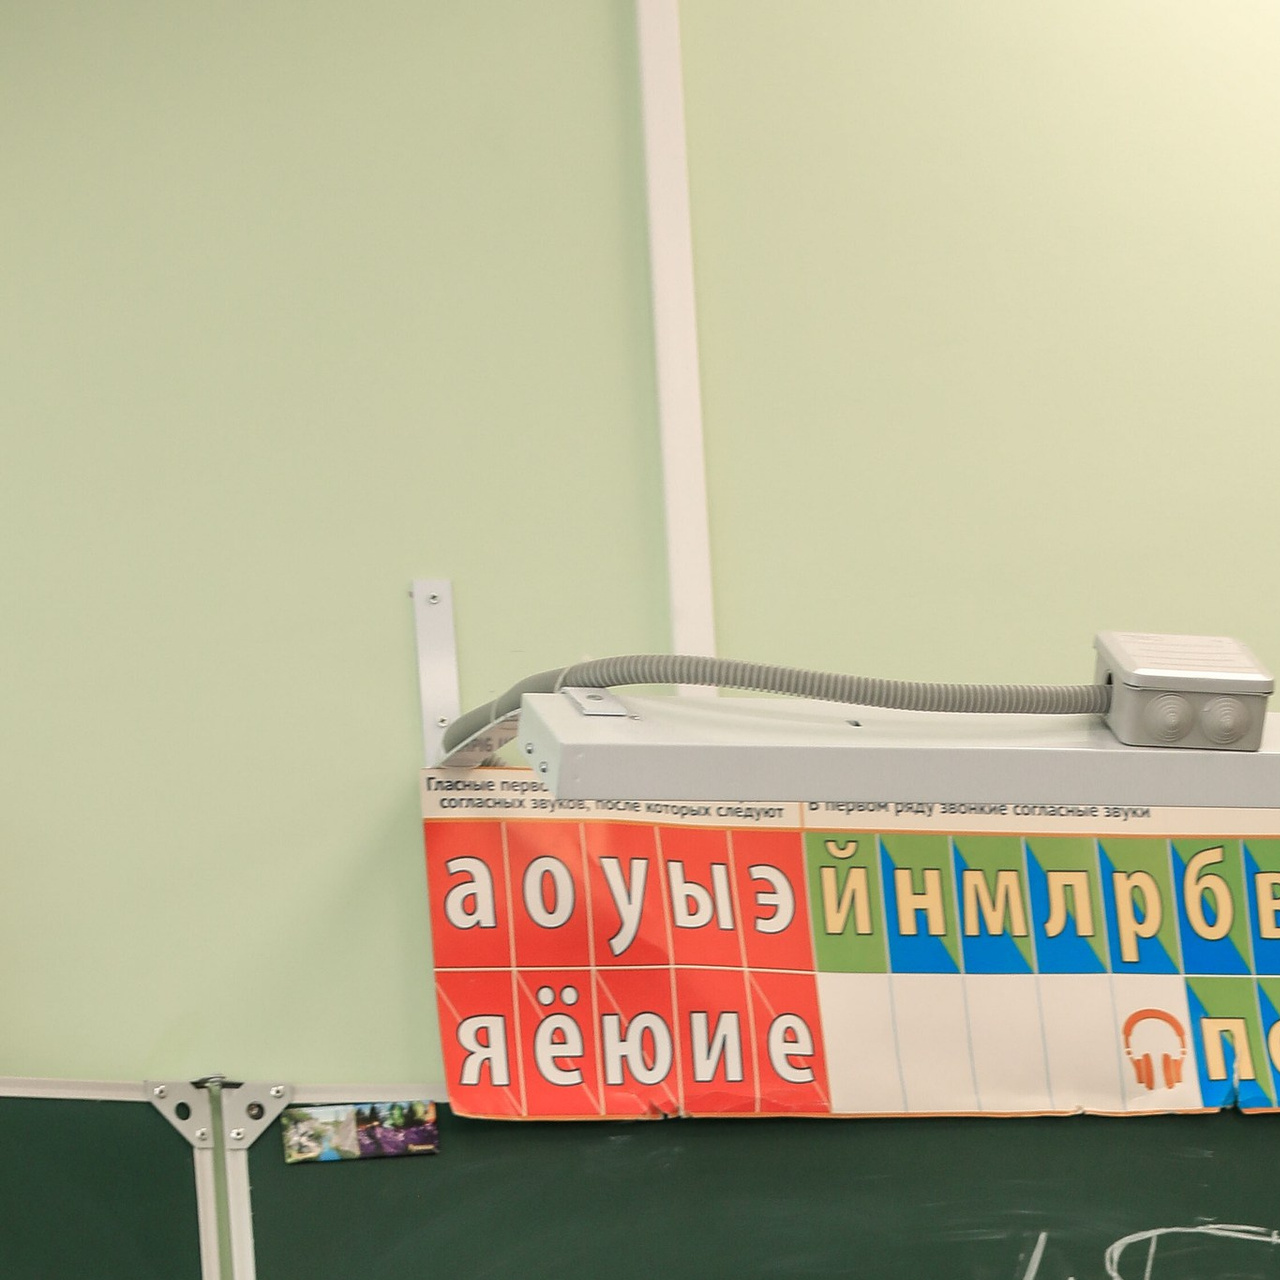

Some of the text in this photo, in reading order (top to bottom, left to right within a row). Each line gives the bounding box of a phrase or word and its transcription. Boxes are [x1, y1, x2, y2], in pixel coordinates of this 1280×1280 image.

[426, 776, 496, 792] Гласные
[439, 797, 526, 810] согласных
[645, 803, 713, 818] которых
[716, 804, 785, 821] следуют
[825, 802, 889, 815] первом
[894, 803, 933, 817] ряду
[939, 803, 1008, 815] звонкие
[1013, 804, 1099, 818] согласные
[1103, 807, 1151, 821] звуки
